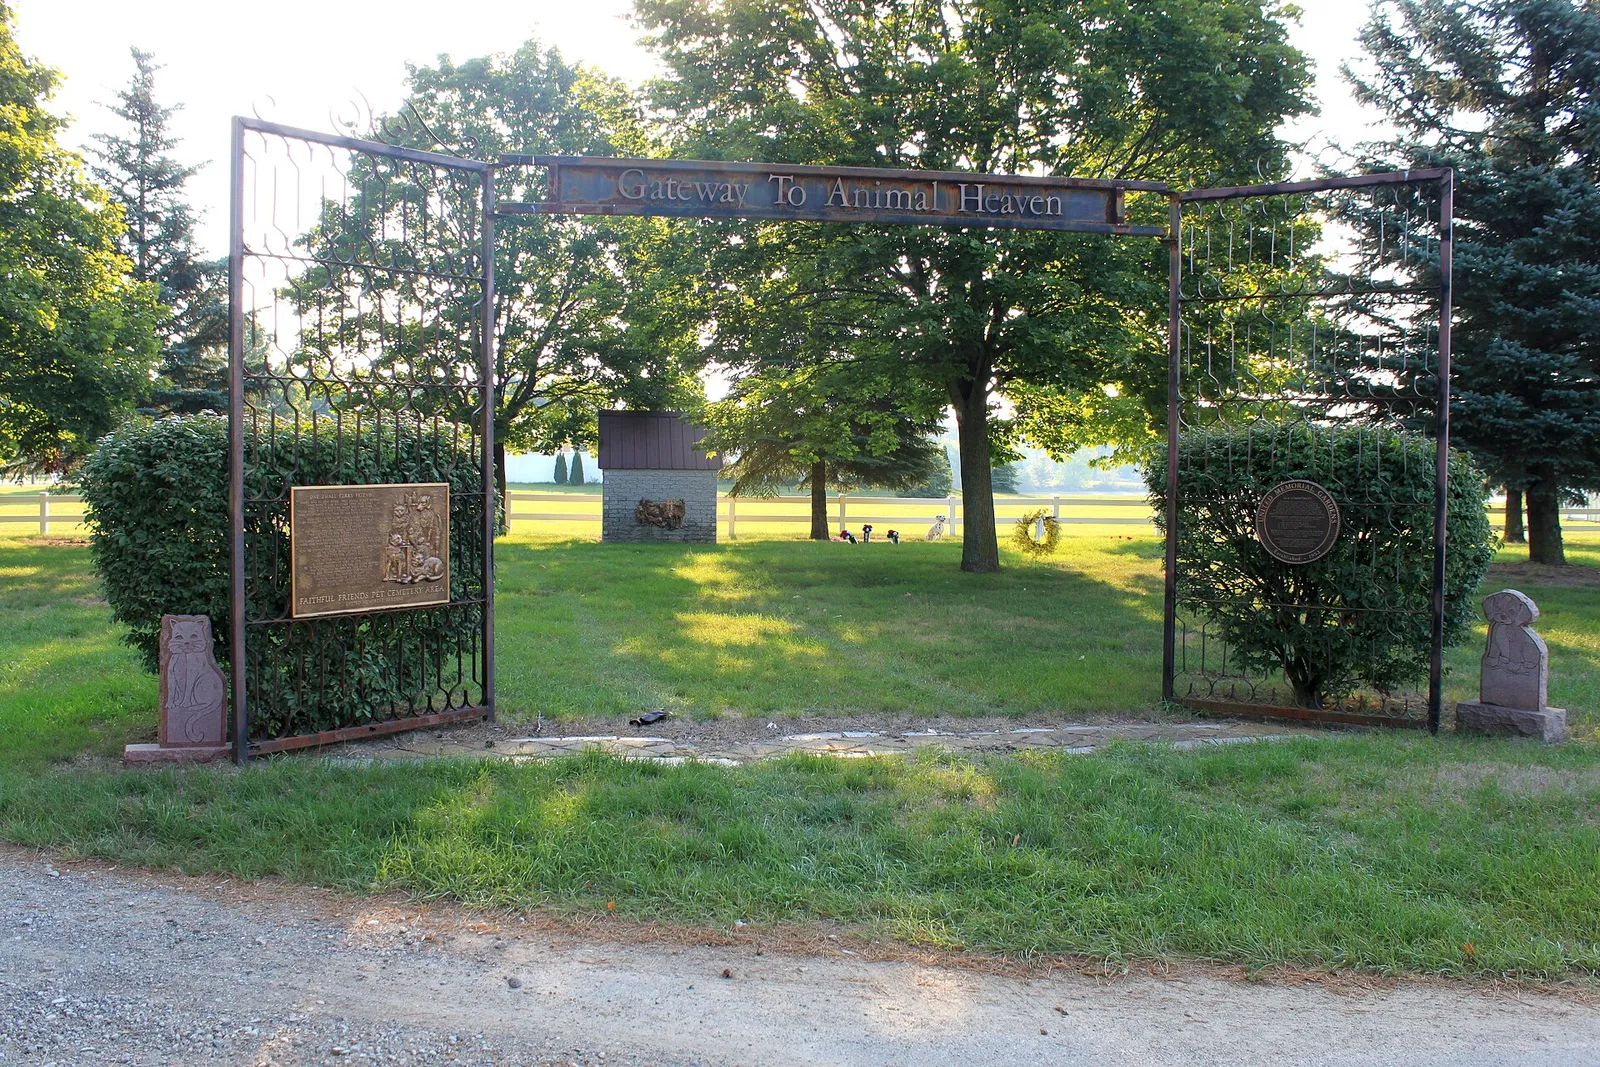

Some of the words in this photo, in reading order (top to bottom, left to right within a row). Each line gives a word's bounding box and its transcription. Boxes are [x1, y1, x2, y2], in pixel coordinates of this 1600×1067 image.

[618, 168, 749, 209] Gateway
[768, 173, 807, 207] To
[824, 176, 940, 212] Animal
[958, 183, 1063, 216] Heaven
[1258, 495, 1274, 523] UNITED
[1273, 482, 1315, 495] MEMORIAL
[1317, 490, 1337, 524] GARDENS
[1273, 549, 1301, 561] Established
[299, 595, 335, 605] FAITHFUL
[338, 592, 369, 602] FRIENDS
[371, 590, 385, 598] PET
[387, 587, 423, 597] CEMETERY
[424, 585, 445, 594] AREA
